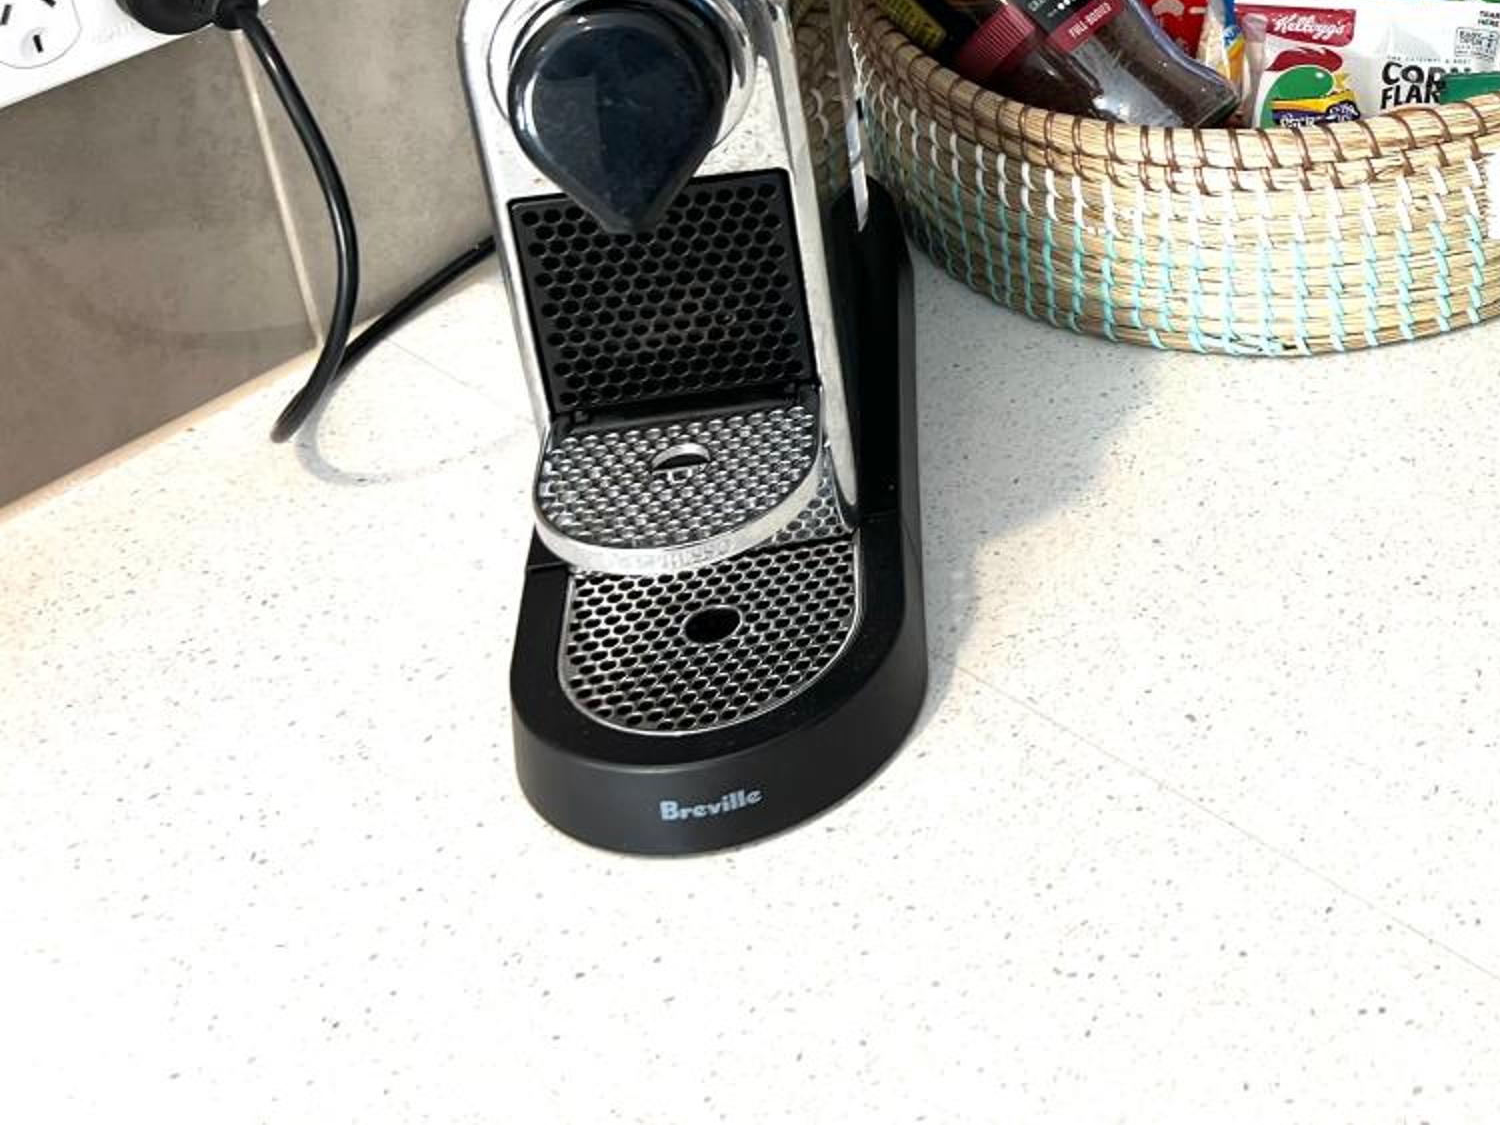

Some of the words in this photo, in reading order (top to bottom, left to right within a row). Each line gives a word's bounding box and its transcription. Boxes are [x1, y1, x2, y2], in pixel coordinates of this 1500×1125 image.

[1271, 13, 1346, 40] Kellogg's
[1381, 61, 1472, 90] COR
[659, 779, 763, 821] Breville
